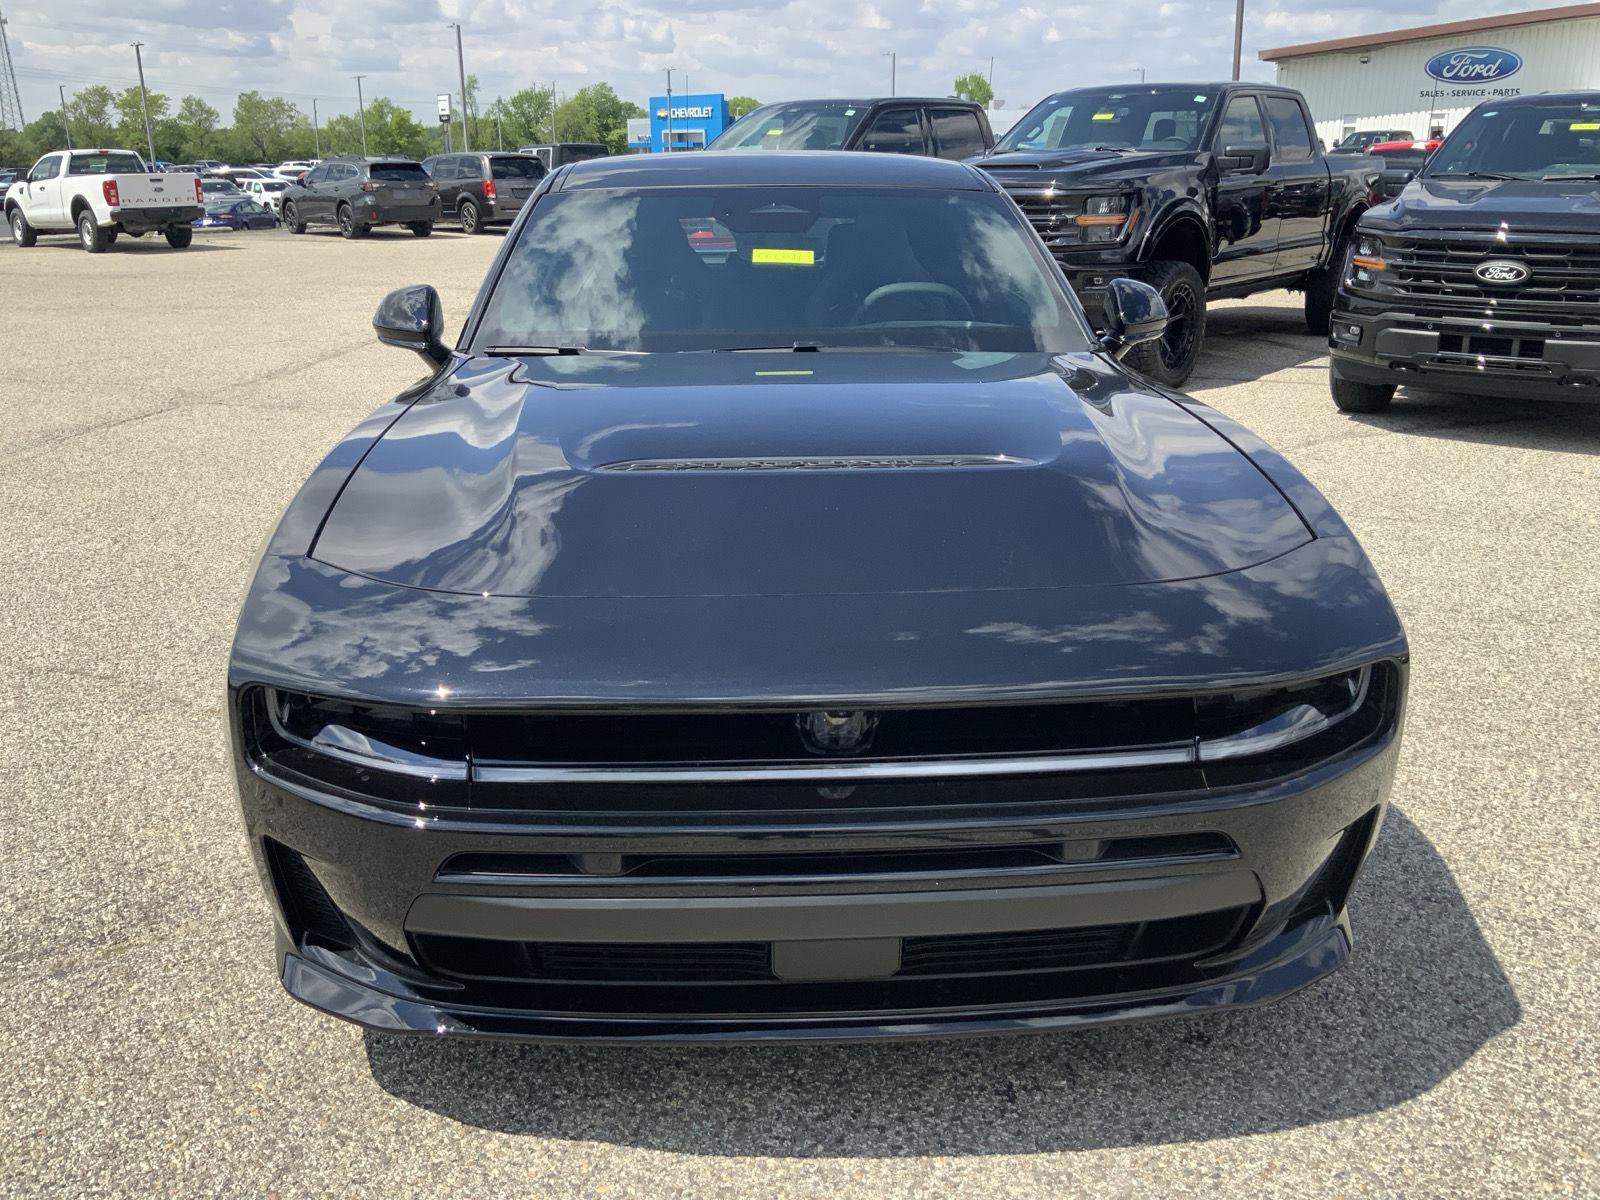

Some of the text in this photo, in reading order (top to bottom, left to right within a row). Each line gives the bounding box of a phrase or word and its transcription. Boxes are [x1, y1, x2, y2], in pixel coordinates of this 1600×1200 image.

[1442, 52, 1503, 78] Ford
[1420, 87, 1520, 98] SALES SERVICE PARTS
[670, 106, 713, 119] CHEVROLET
[1485, 266, 1517, 279] Ford
